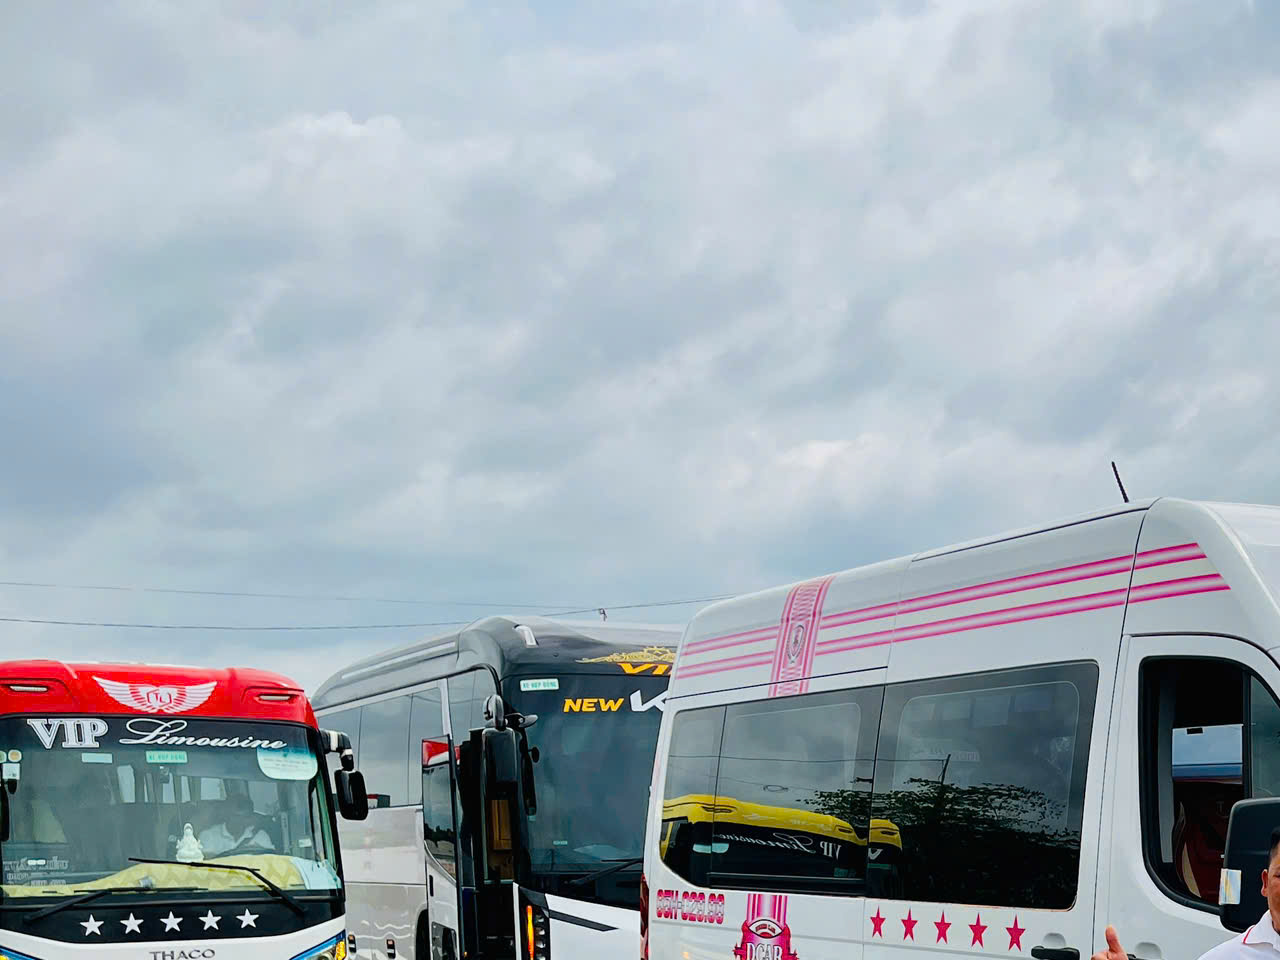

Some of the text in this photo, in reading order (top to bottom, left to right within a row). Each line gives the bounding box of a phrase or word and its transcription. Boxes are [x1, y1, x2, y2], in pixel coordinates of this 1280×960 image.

[616, 662, 673, 675] VI
[563, 698, 624, 712] NEW
[27, 718, 287, 749] VIP Limousine
[149, 948, 216, 960] THACO
